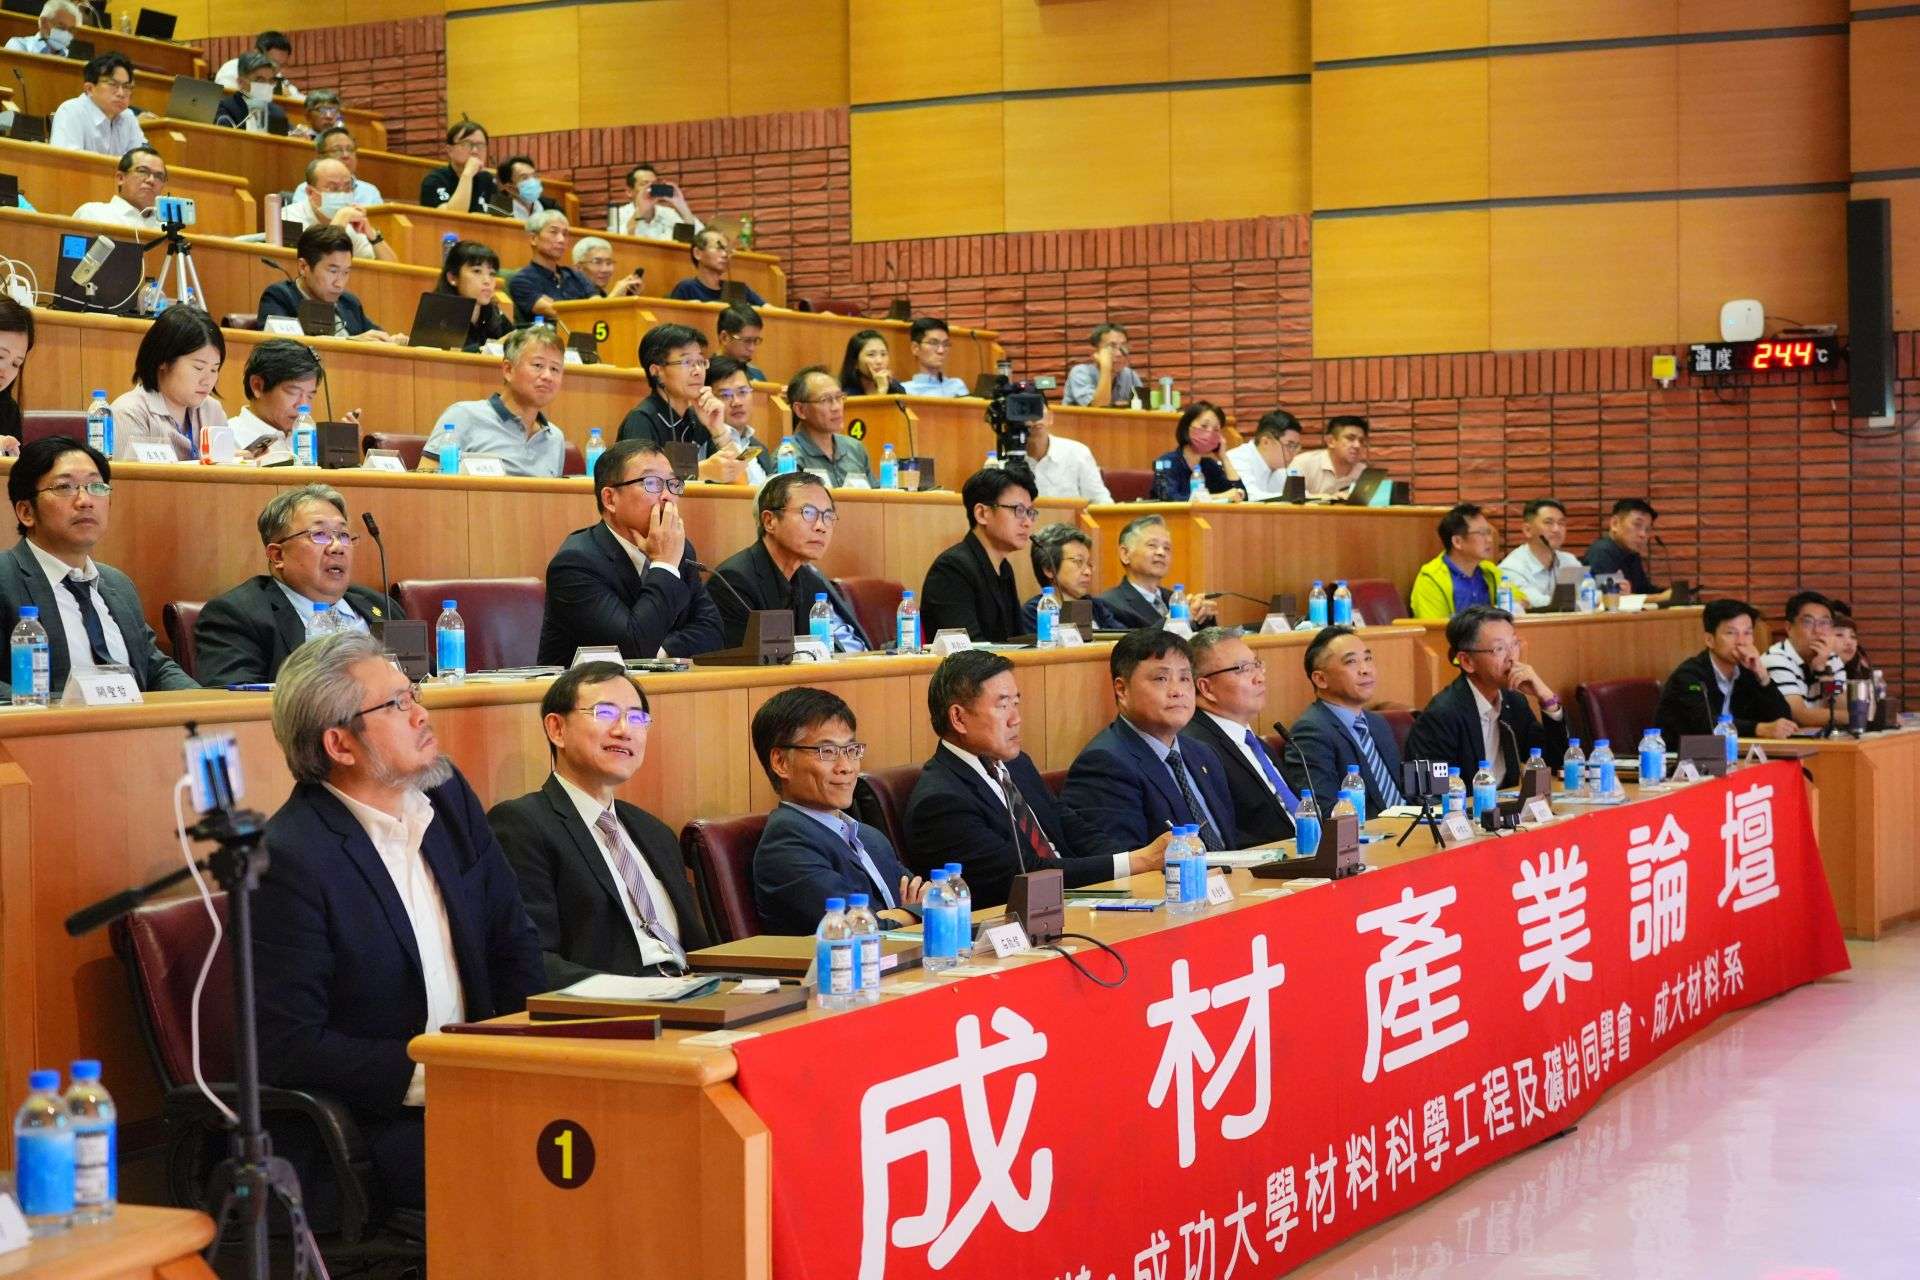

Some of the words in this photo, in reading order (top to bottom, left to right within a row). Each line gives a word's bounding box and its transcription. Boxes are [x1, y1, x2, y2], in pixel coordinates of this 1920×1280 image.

[596, 322, 608, 341] 5
[850, 421, 864, 440] 4
[554, 1130, 573, 1179] 1
